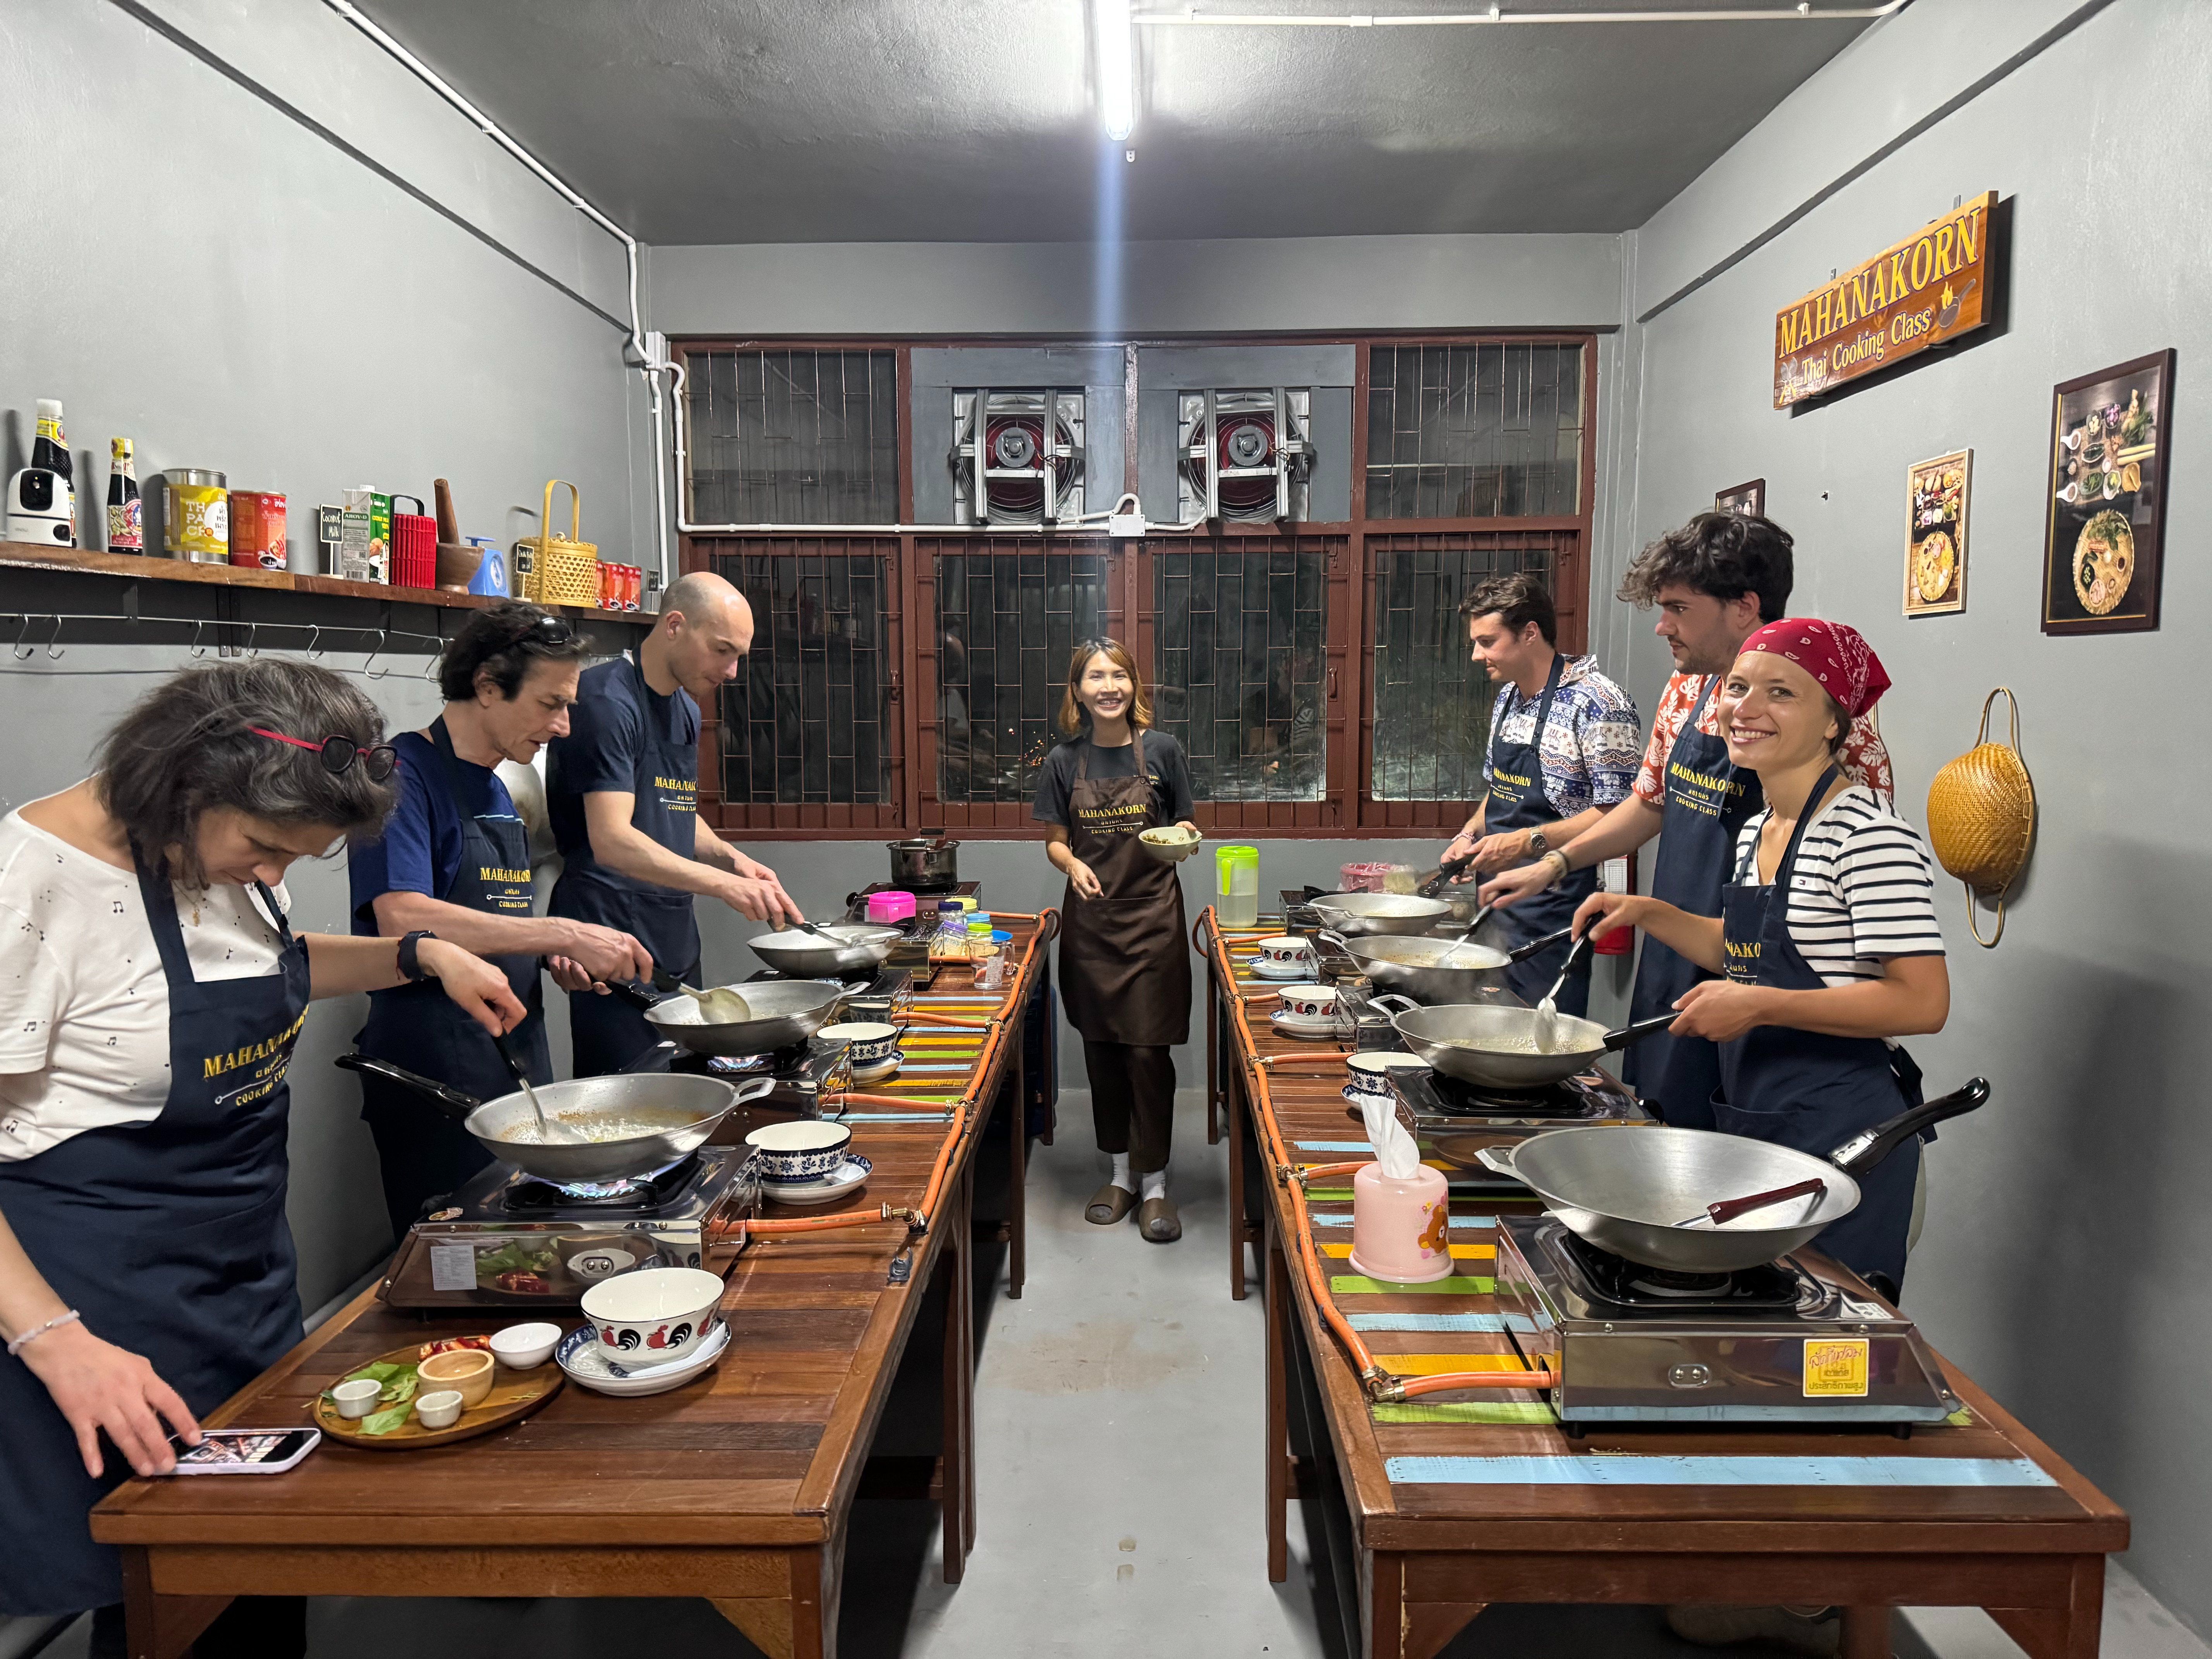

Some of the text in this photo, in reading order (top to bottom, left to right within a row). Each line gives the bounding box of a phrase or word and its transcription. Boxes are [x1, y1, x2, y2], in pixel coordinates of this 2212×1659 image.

[1779, 208, 1980, 359] MAHANAKORN
[1802, 309, 1931, 385] Thai Cooking Class
[322, 511, 341, 524] Coconut
[329, 526, 339, 538] Milk
[1670, 761, 1746, 797] MAHANAKORN
[1078, 804, 1146, 818] MAHANAKORN
[1676, 796, 1717, 816] COOKING CLASS
